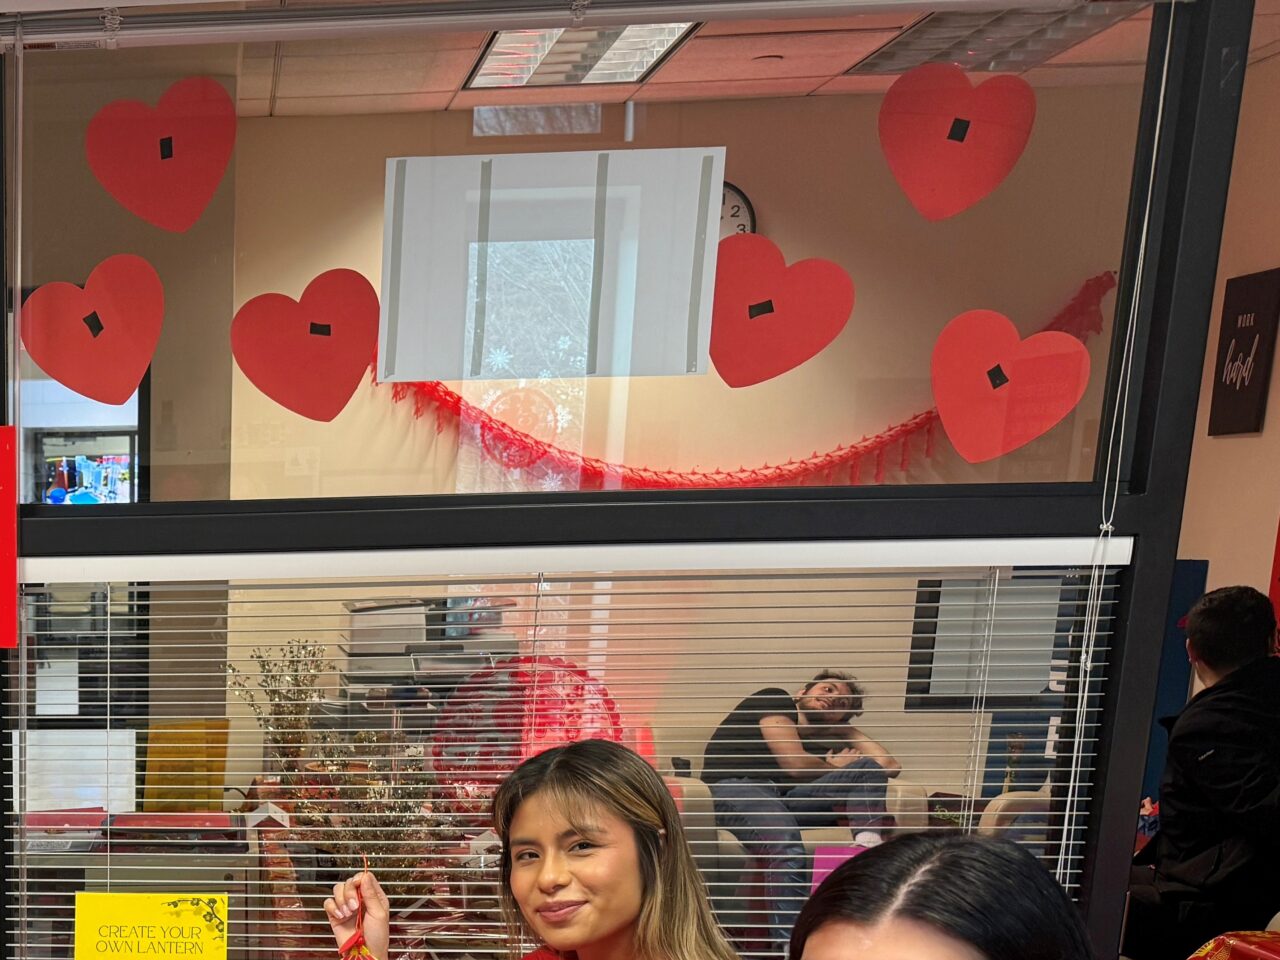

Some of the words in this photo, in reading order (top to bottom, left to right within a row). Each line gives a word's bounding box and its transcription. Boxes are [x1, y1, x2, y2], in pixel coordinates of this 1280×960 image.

[730, 204, 740, 218] 2
[1237, 313, 1255, 328] WORK
[1222, 333, 1260, 390] hard
[98, 925, 156, 939] CREATE
[160, 926, 202, 939] YOUR
[95, 940, 134, 954] OWN
[137, 941, 204, 955] LANTERN
